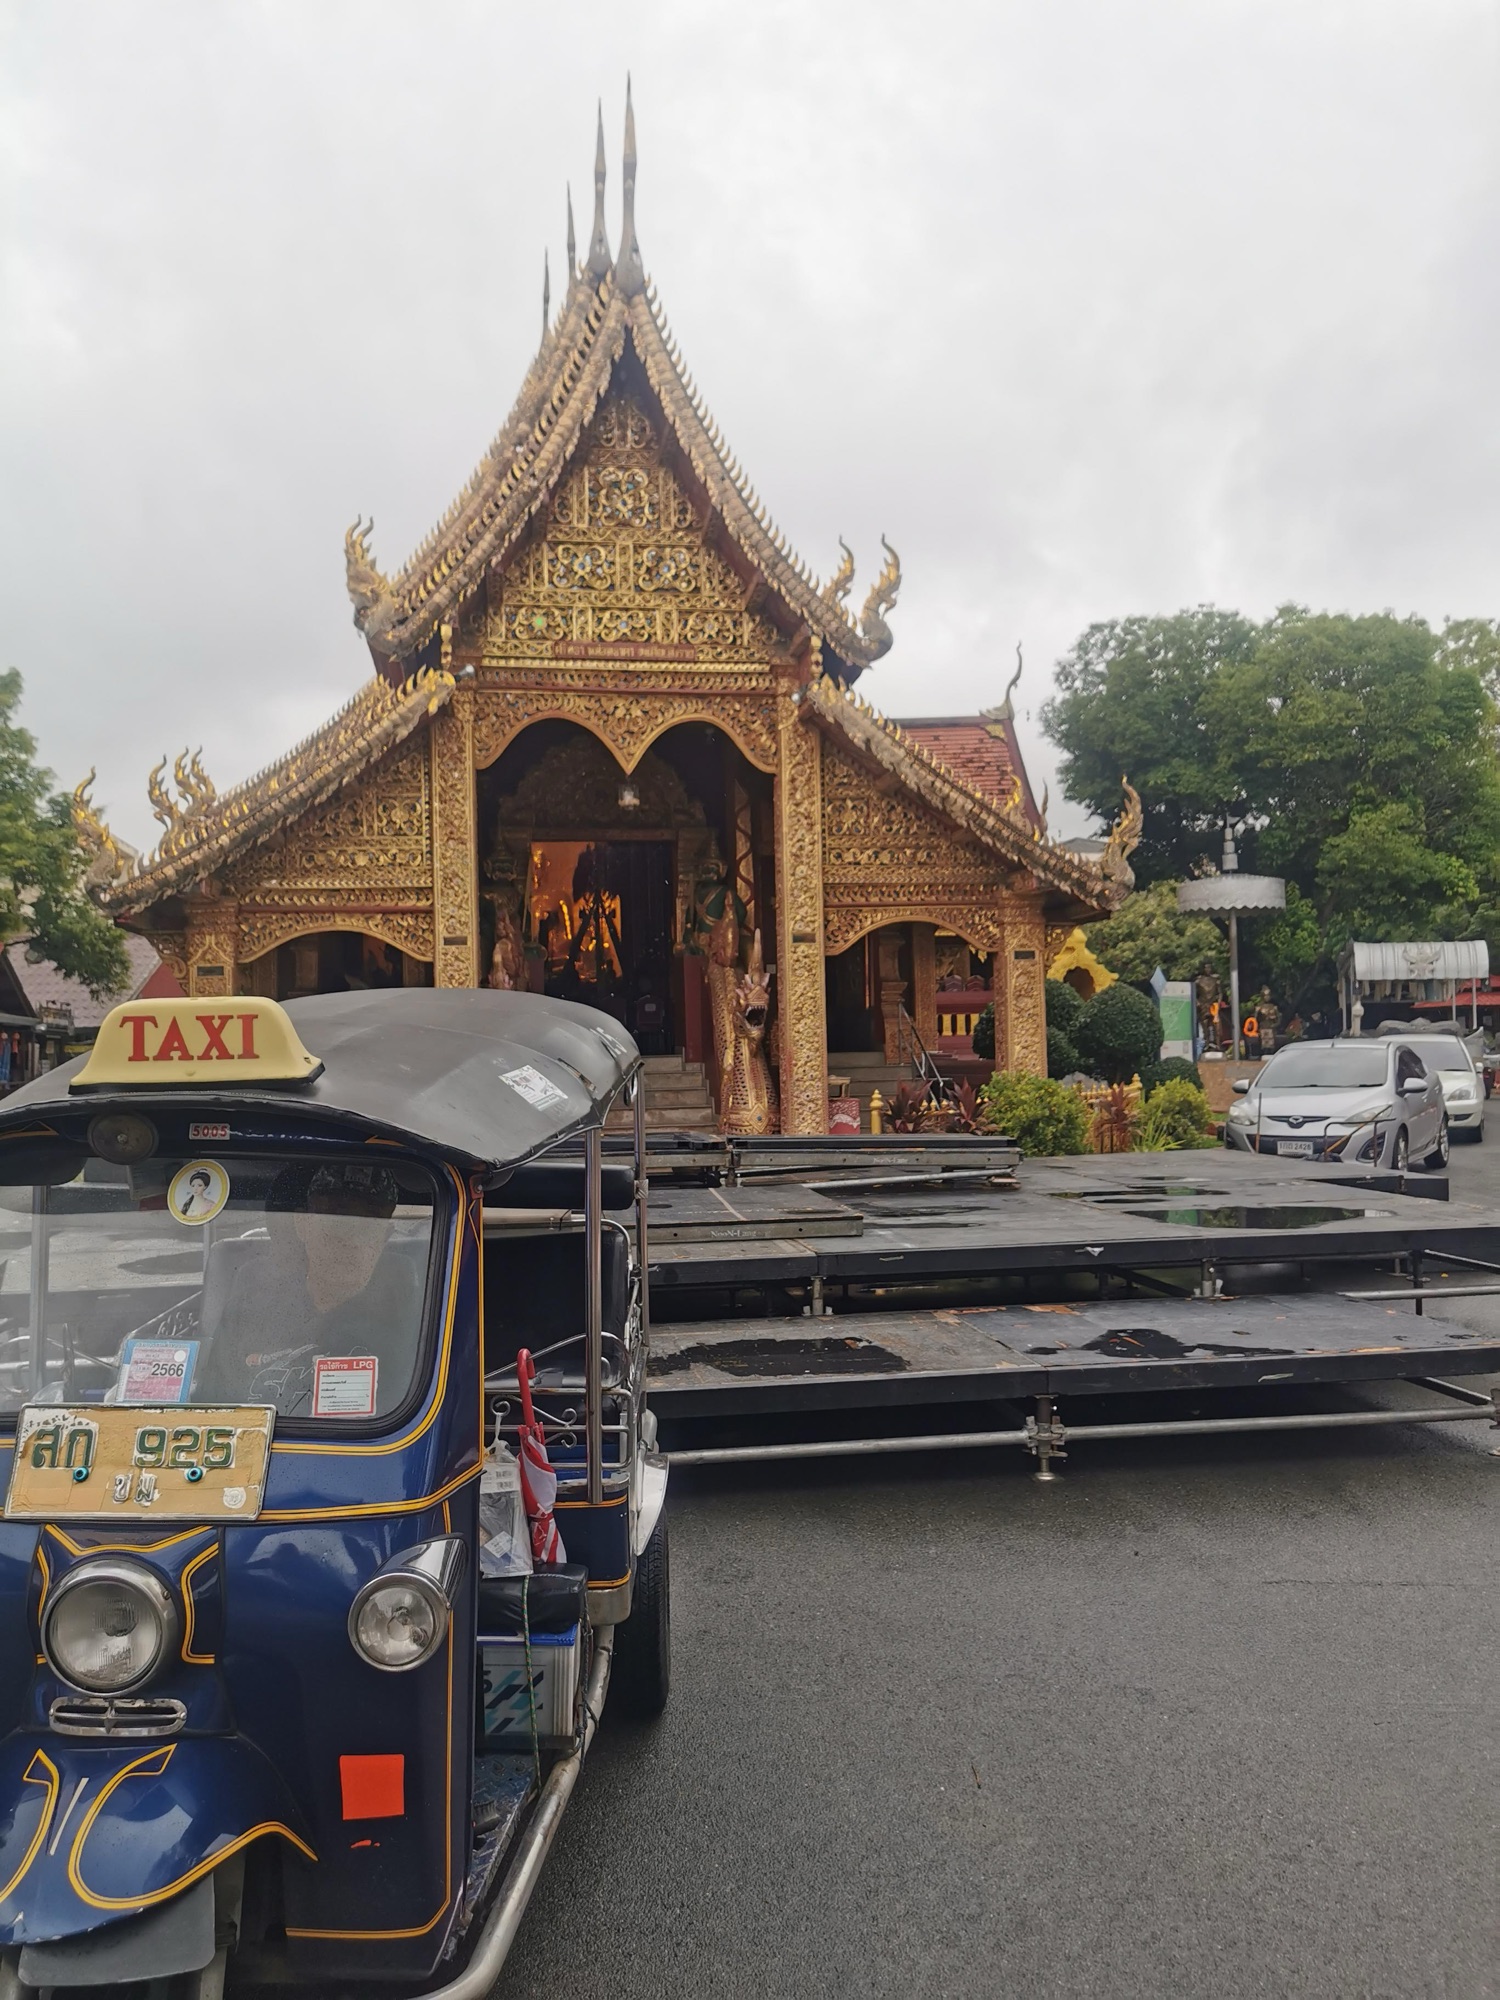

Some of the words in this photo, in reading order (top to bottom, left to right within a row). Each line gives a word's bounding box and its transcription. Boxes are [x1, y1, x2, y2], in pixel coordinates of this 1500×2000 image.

[119, 1014, 260, 1061] TAXI
[192, 1125, 228, 1137] 5005
[151, 1362, 185, 1377] 2566
[353, 1360, 373, 1369] LPG
[31, 1424, 97, 1467] สก
[133, 1426, 235, 1467] 925
